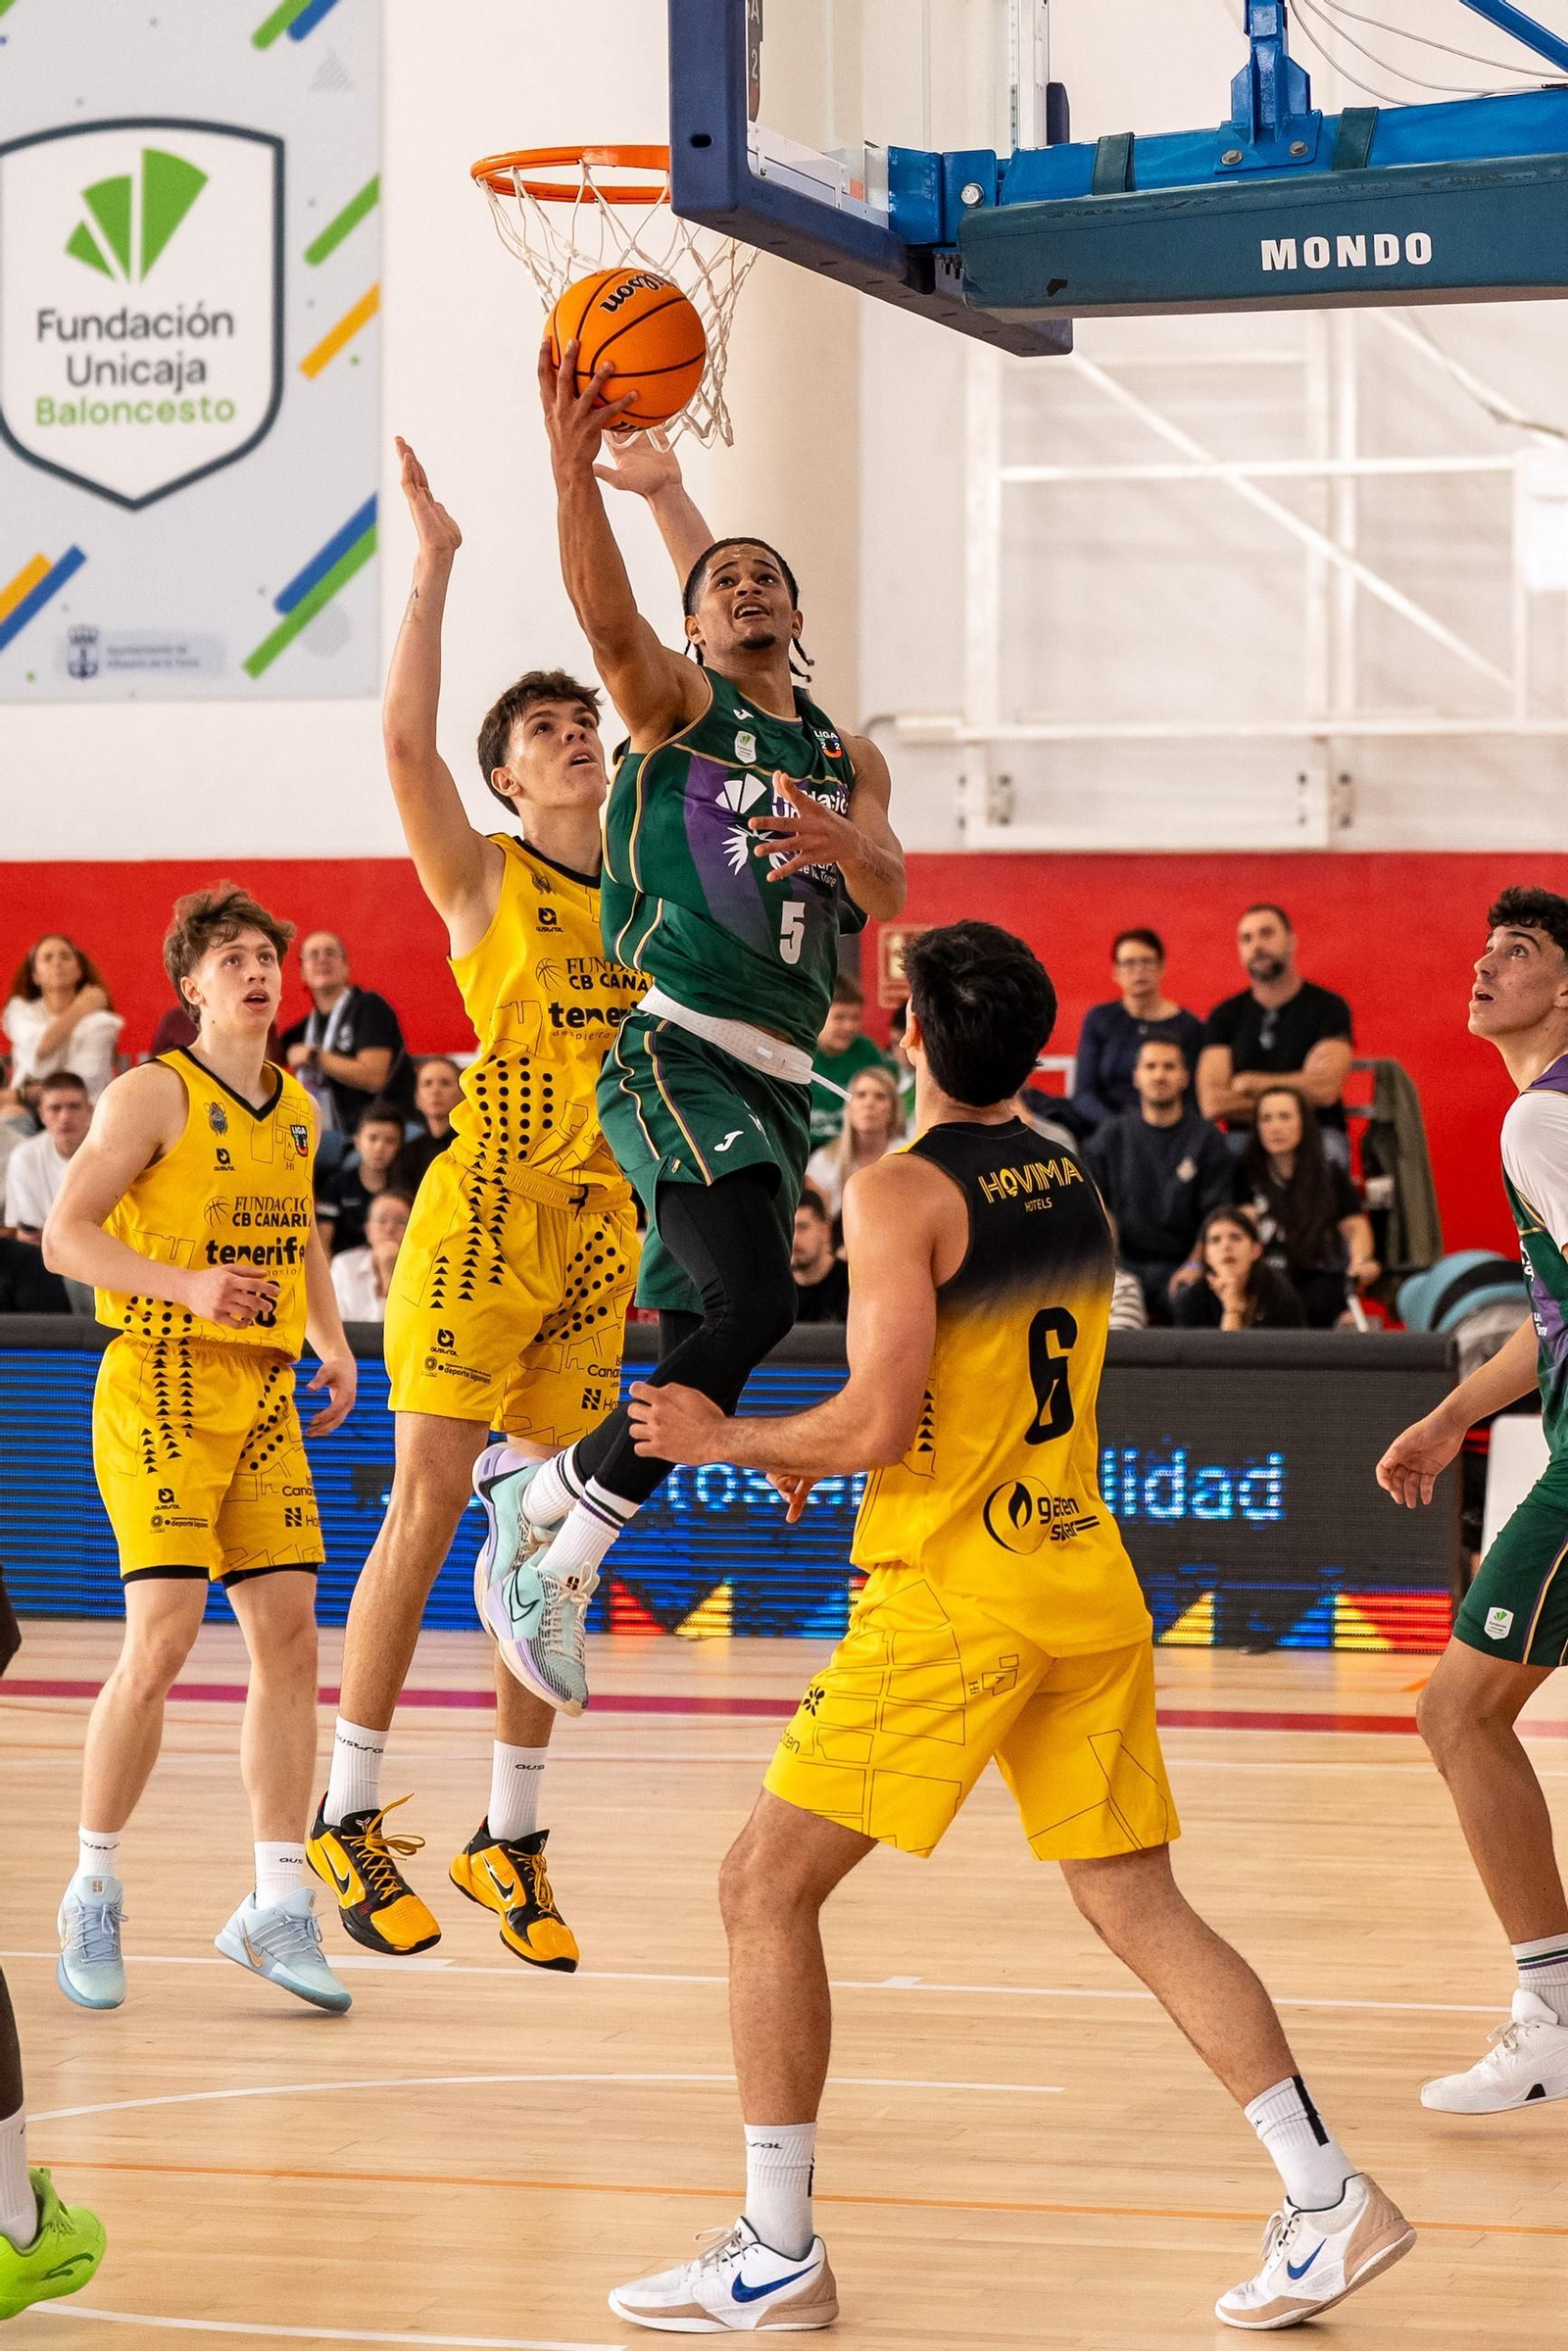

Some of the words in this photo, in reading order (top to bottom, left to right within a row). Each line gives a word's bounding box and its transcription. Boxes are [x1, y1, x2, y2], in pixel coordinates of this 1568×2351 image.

[1260, 231, 1433, 271] MONDO
[36, 302, 235, 343] Fundación
[66, 354, 208, 392] Unicaja
[35, 396, 236, 426] Baloncesto
[813, 730, 839, 739] LIGA
[779, 901, 806, 964] 5
[568, 974, 594, 991] CB
[599, 973, 649, 994] CANA
[977, 1156, 1085, 1203] HOVIMA
[234, 1194, 312, 1212] FUNDACIÓ
[1024, 1197, 1054, 1212] HOTELS
[231, 1212, 252, 1227] CB
[255, 1212, 311, 1227] CANARI
[587, 1363, 620, 1379] Cana
[1024, 1306, 1078, 1445] 6
[281, 1485, 313, 1497] Cana
[1102, 1447, 1285, 1519] lidad
[336, 1734, 384, 1754] austra
